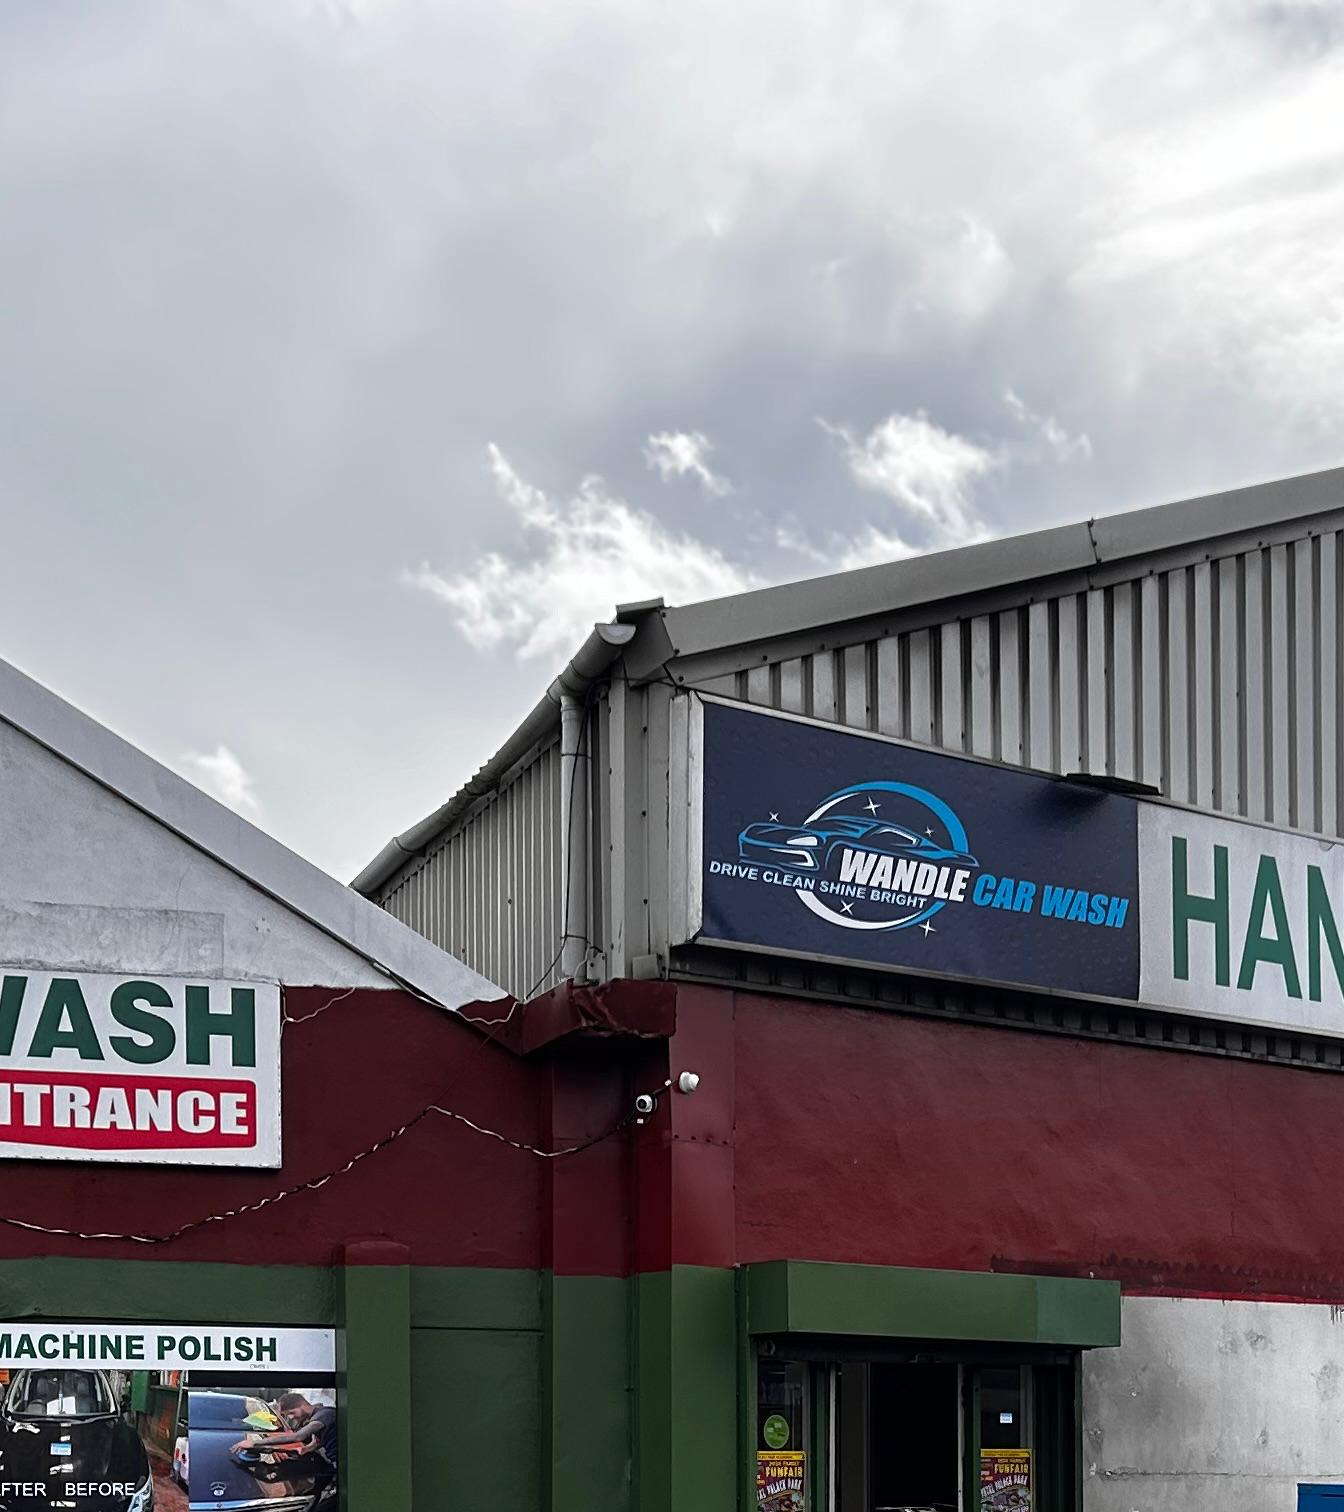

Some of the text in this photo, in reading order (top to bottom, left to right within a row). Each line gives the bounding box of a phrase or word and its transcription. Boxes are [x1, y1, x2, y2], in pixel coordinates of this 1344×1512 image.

[709, 860, 927, 909] DRIVE CLEAN SHINE BRIGHT
[839, 848, 1130, 928] WANDLE CAR WASH
[156, 1335, 278, 1362] POLISH
[765, 1466, 803, 1478] FUNFAIR
[64, 1481, 136, 1497] BEFORE
